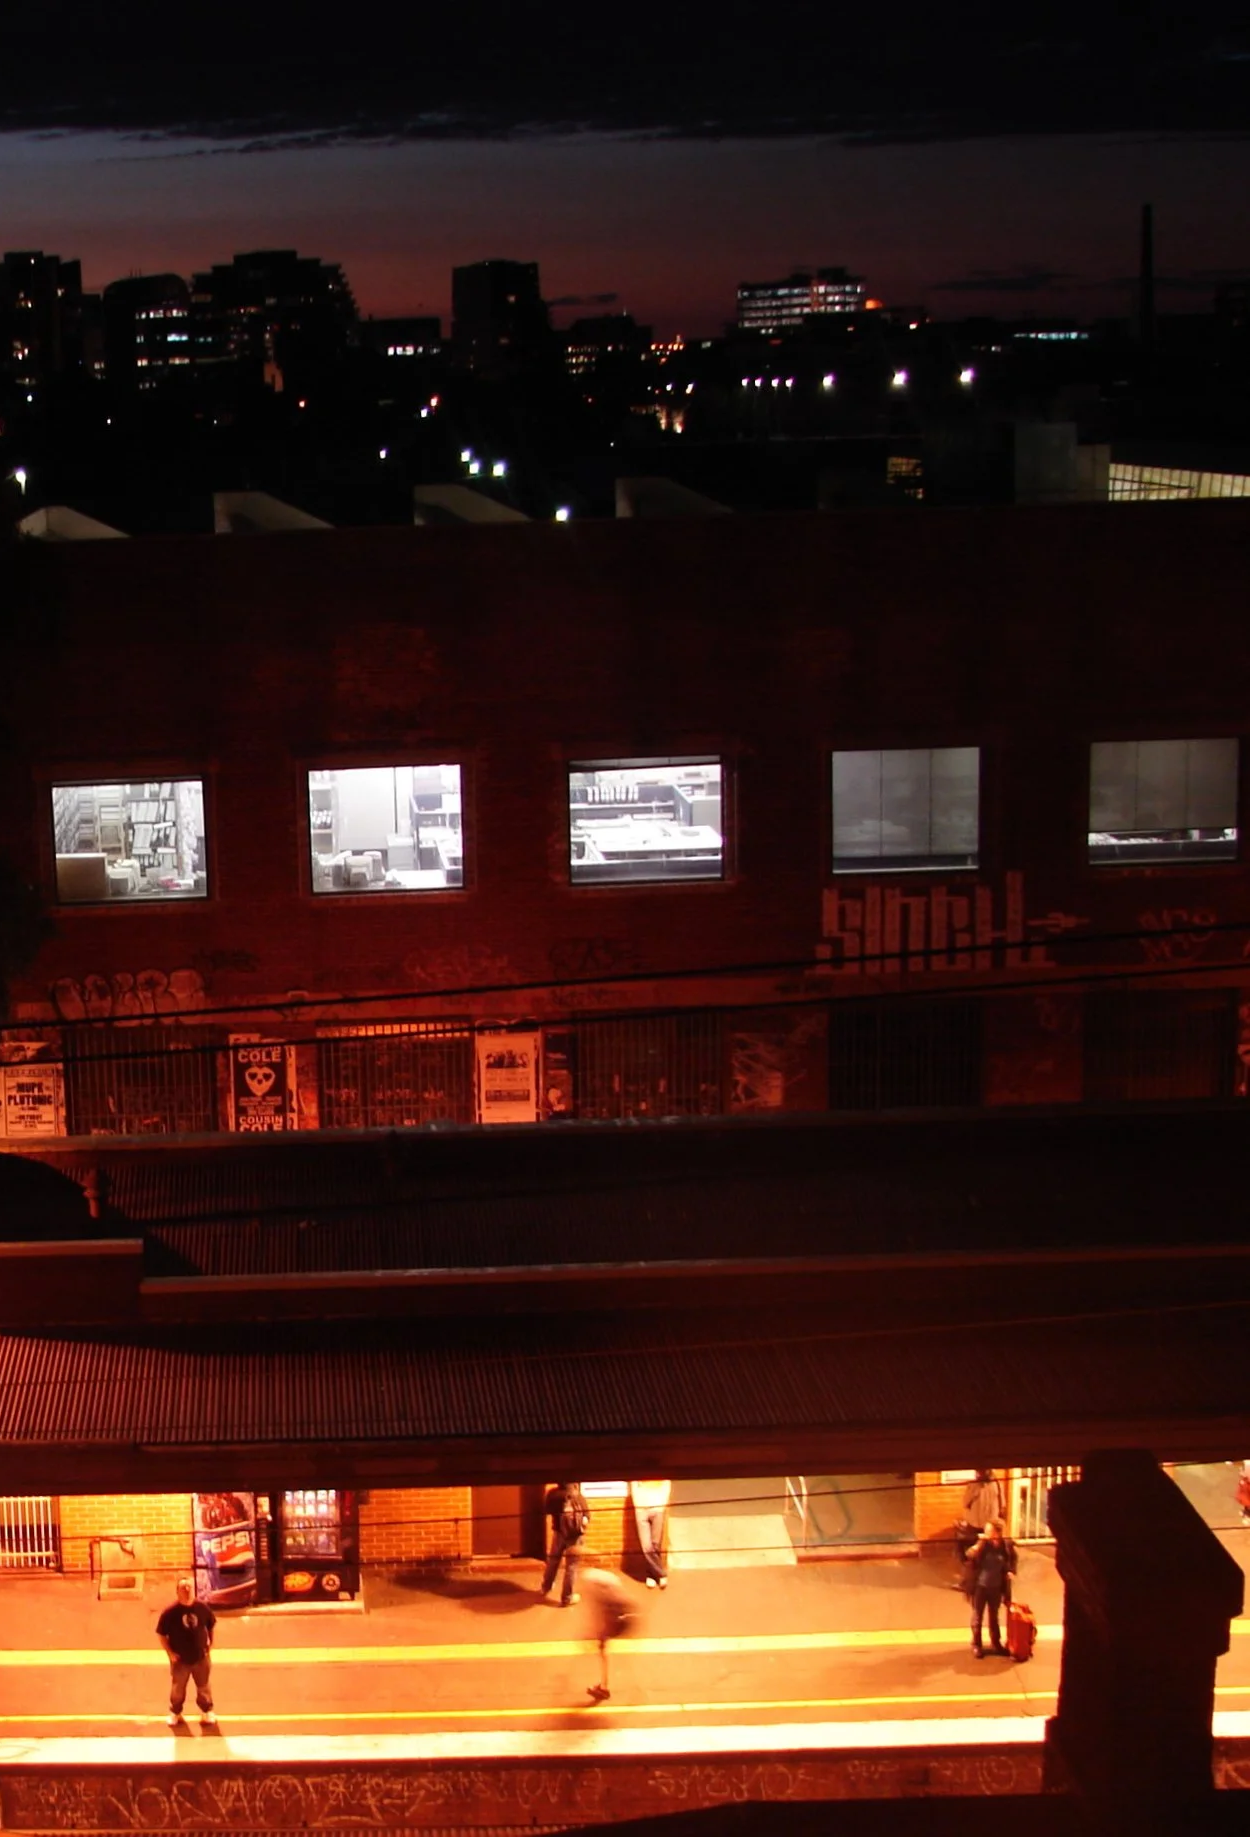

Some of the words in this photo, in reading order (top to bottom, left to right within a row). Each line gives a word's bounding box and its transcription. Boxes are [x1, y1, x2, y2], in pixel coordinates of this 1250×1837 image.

[238, 1050, 282, 1063] COLE
[239, 1115, 283, 1124] COUSIN
[200, 1530, 250, 1556] PEPSI
